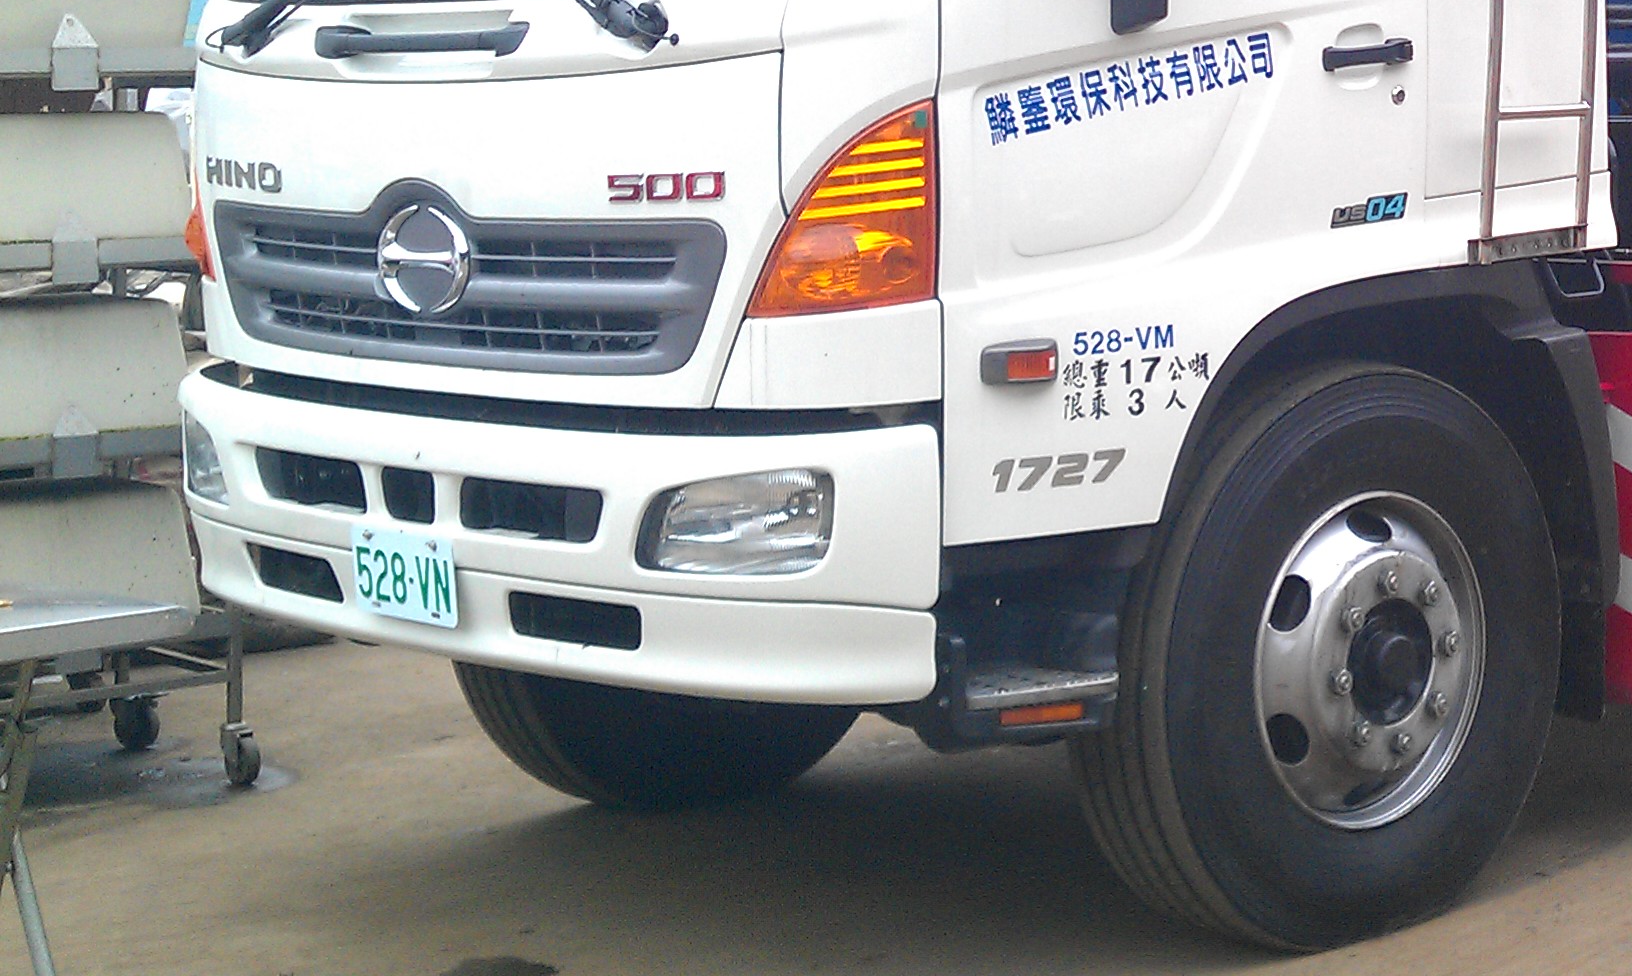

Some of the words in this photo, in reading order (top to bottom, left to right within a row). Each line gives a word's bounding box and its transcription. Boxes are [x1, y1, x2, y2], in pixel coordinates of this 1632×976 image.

[206, 156, 283, 193] HINO
[607, 171, 727, 204] 500
[1073, 324, 1175, 356] 528-VM
[1063, 358, 1110, 389] 總重
[1120, 356, 1161, 385] 17
[1064, 389, 1110, 421] 限乘
[1127, 388, 1145, 416] 3
[1165, 389, 1187, 410] 人
[992, 448, 1126, 493] 1727
